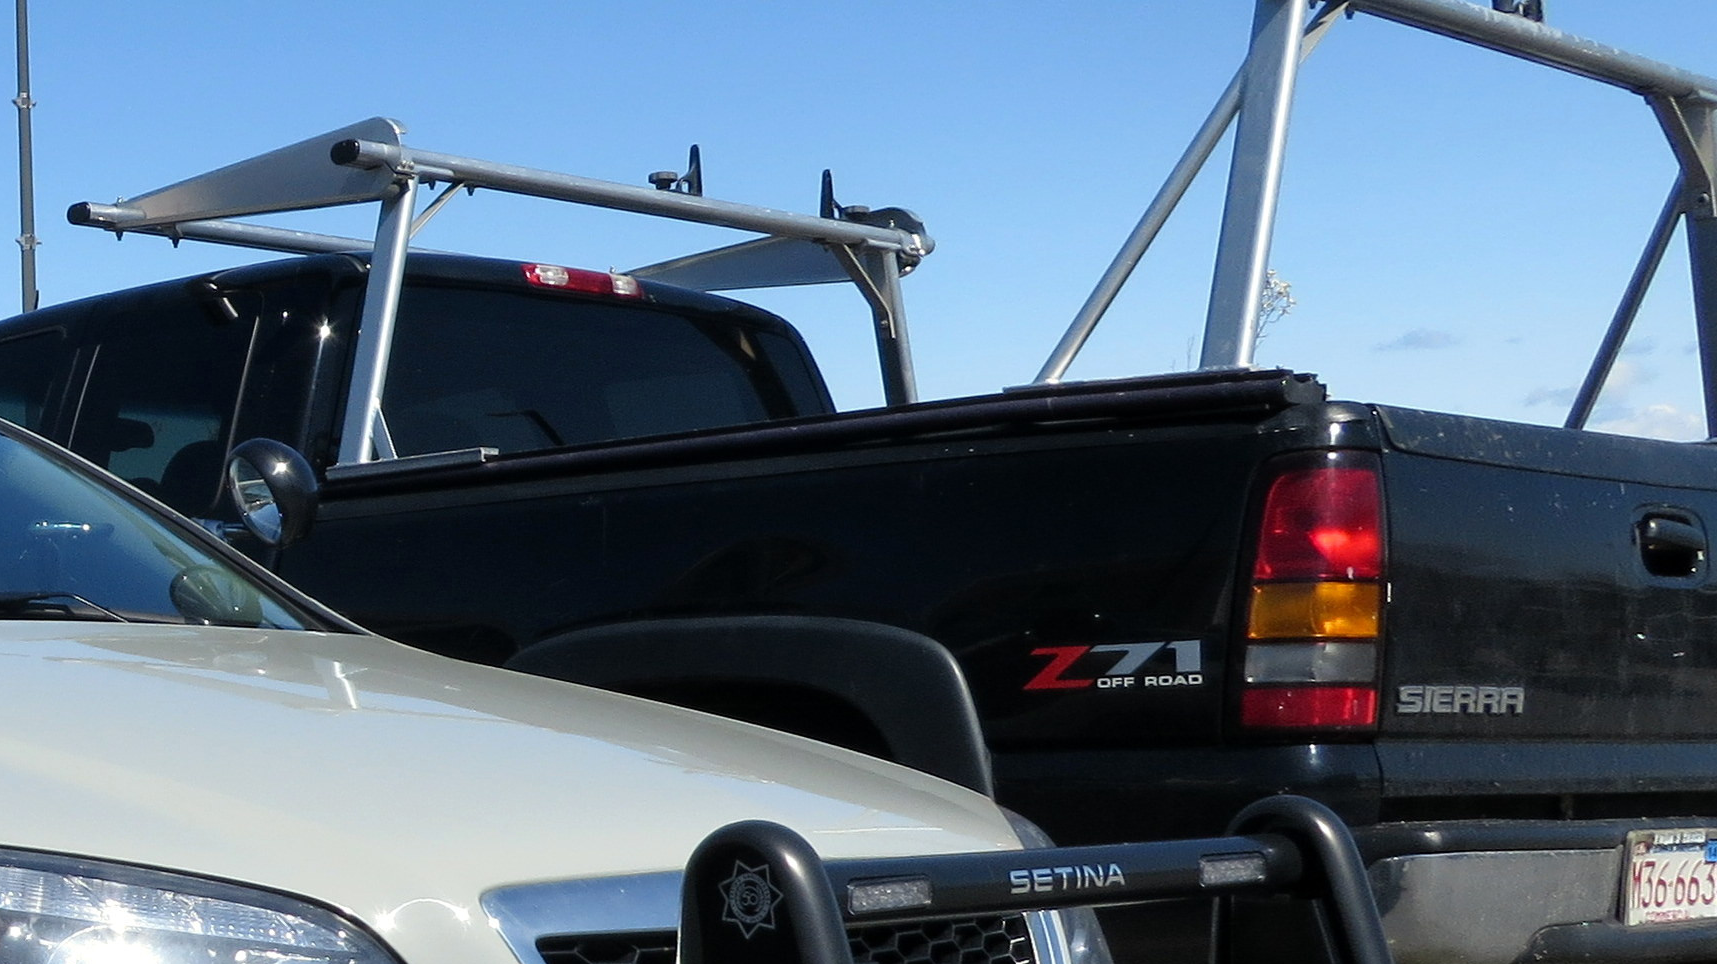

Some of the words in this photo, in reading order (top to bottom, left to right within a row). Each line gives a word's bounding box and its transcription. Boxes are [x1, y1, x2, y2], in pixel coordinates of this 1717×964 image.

[1024, 640, 1201, 690] Z71
[1097, 677, 1137, 689] OFF
[1145, 673, 1203, 688] ROAD
[1397, 685, 1525, 715] SIERRA
[1009, 862, 1126, 896] SETINA
